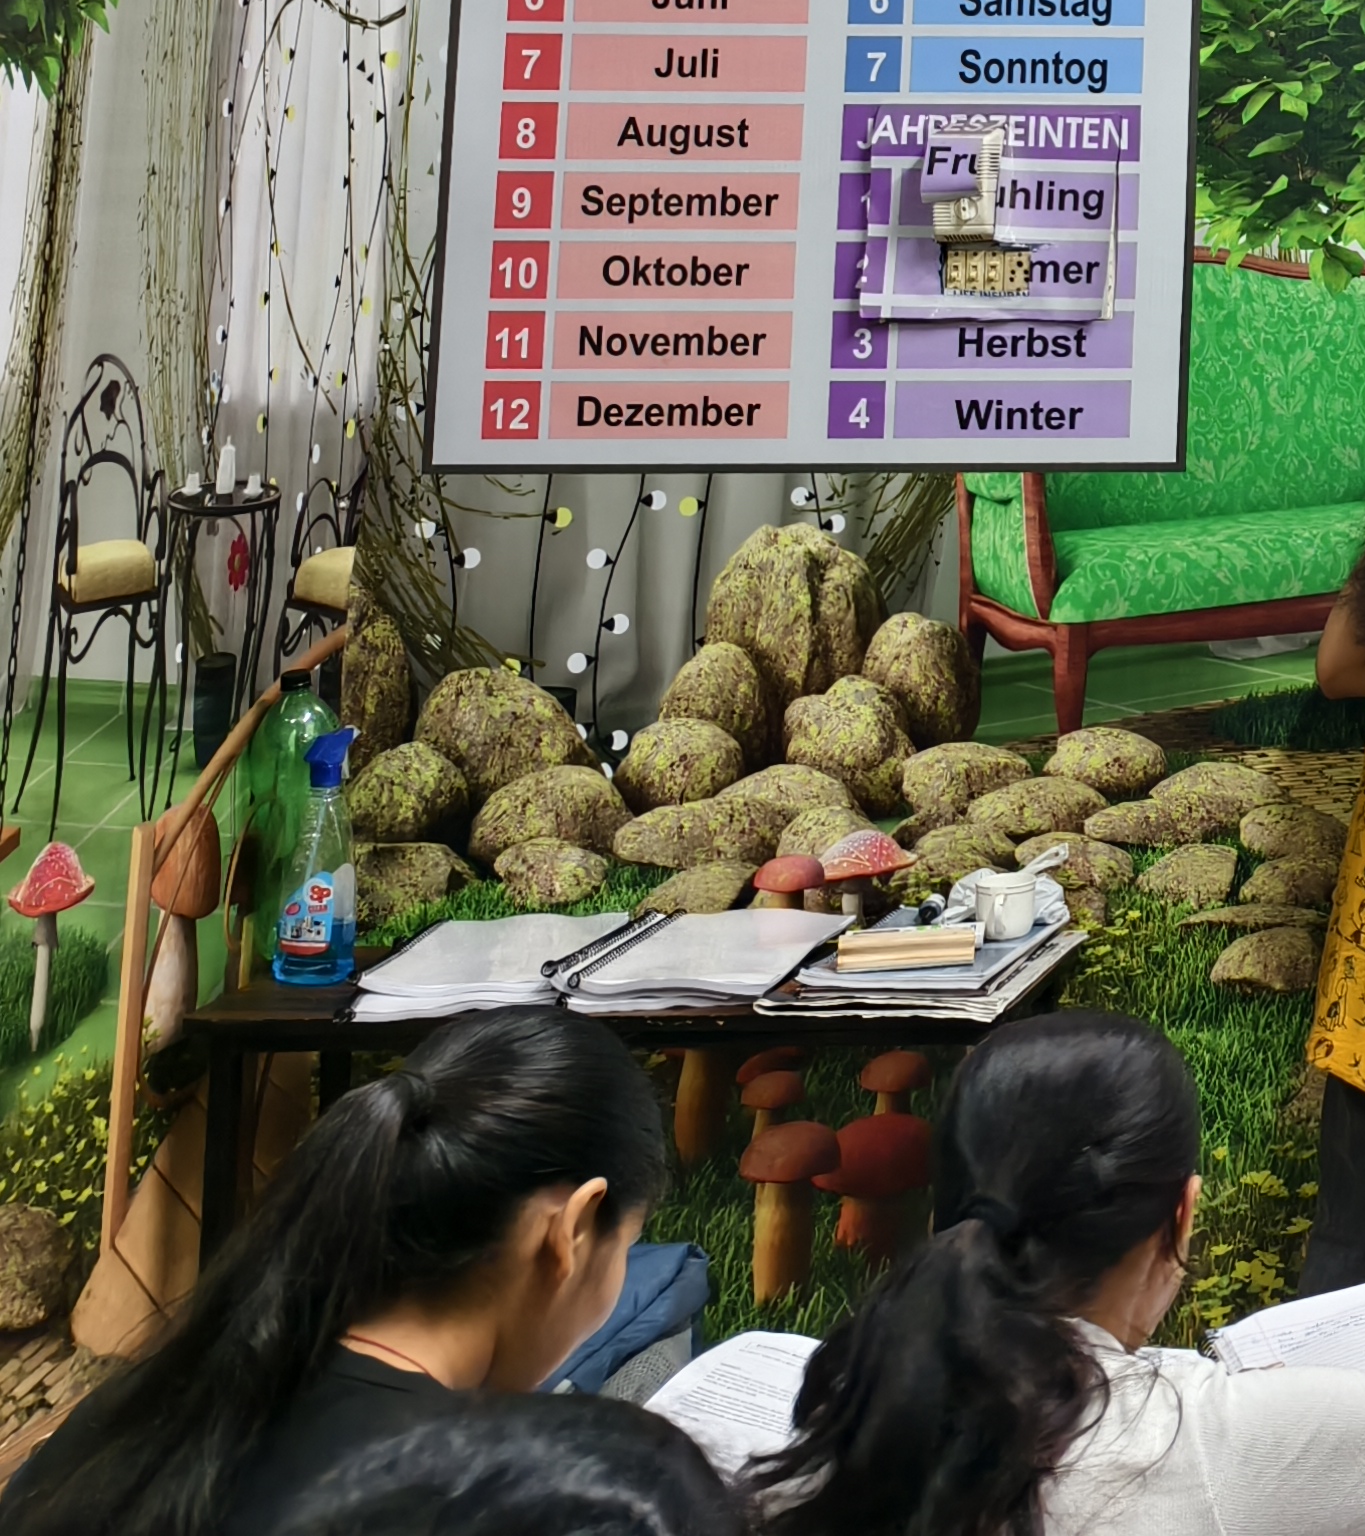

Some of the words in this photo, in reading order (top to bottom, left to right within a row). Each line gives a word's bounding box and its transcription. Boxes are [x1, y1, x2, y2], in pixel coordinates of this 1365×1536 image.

[521, 49, 541, 80] 7
[654, 47, 719, 79] Juli
[867, 52, 887, 82] 7
[516, 117, 536, 149] 8
[617, 116, 750, 155] August
[512, 186, 532, 219] 9
[580, 184, 779, 224] September
[496, 255, 539, 290] 10
[602, 255, 750, 287] Oktober
[493, 327, 531, 359] 11
[578, 325, 767, 357] November
[852, 328, 873, 359] 3
[956, 325, 1089, 359] Herbst
[490, 398, 530, 430] 12
[577, 395, 762, 427] Dezember
[848, 397, 870, 429] 4
[954, 399, 1084, 431] Winter
